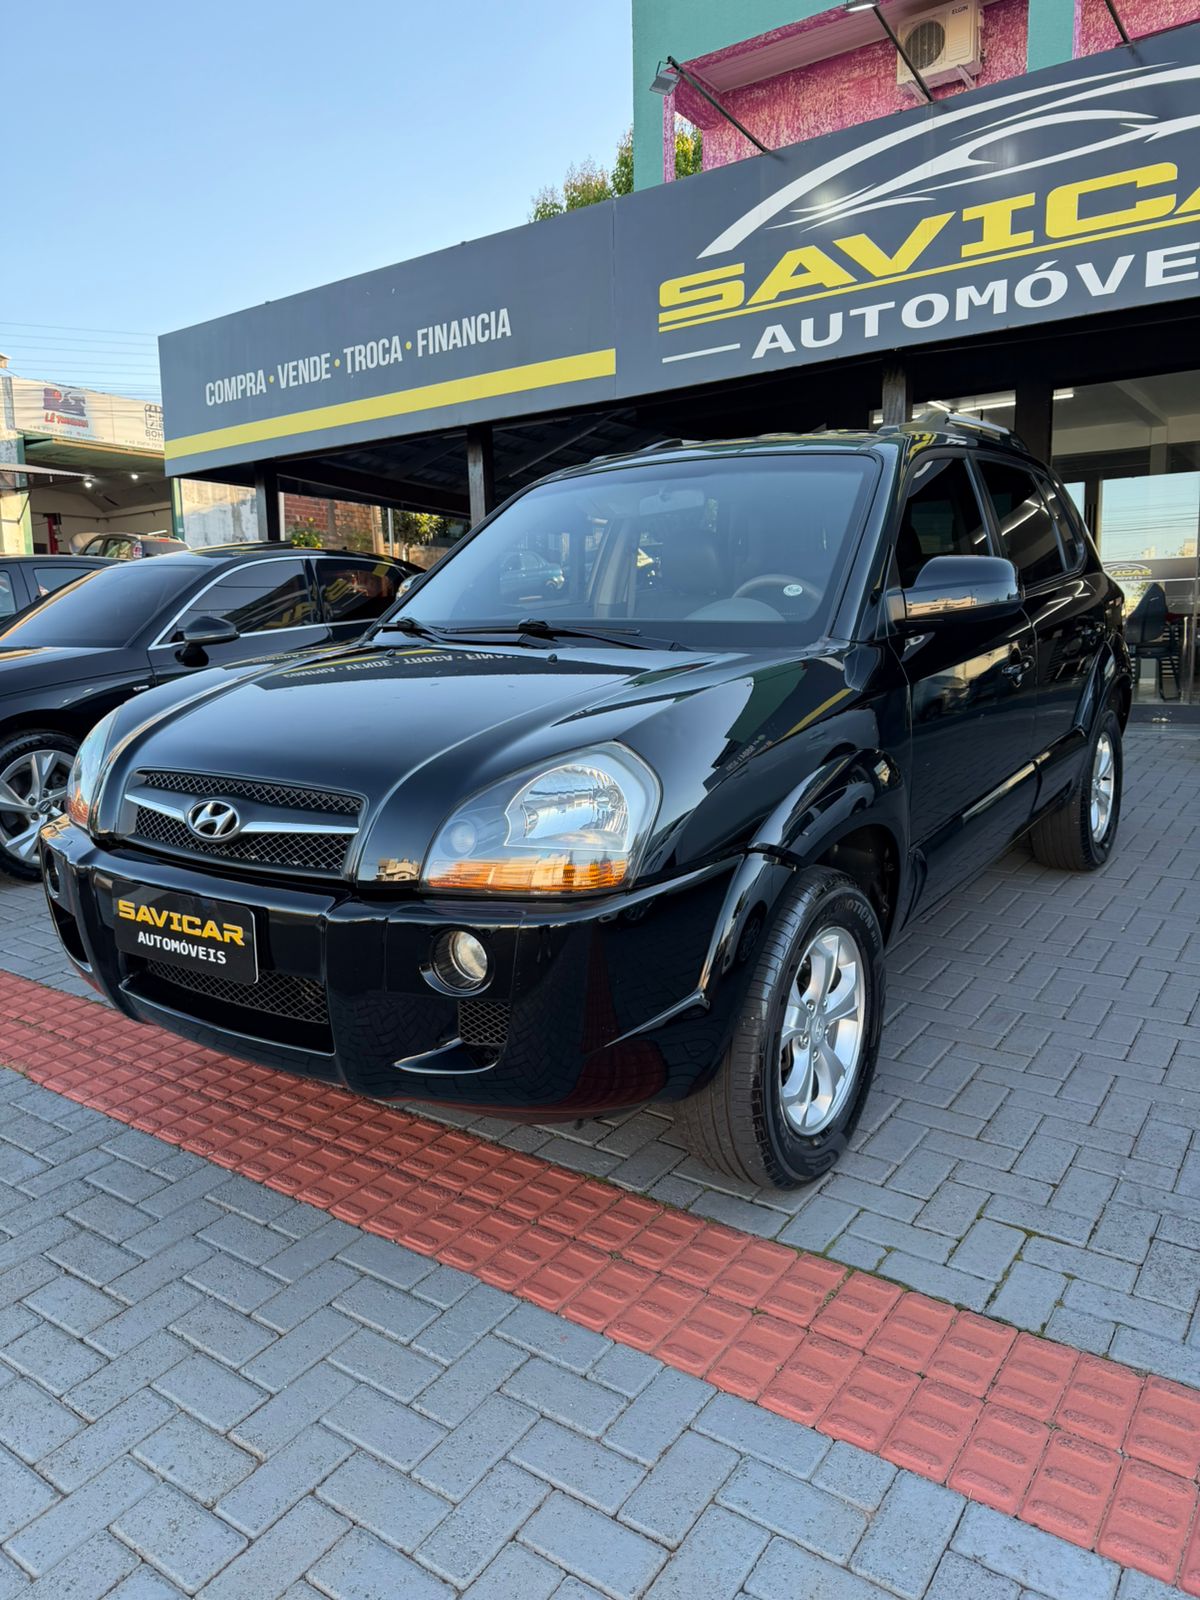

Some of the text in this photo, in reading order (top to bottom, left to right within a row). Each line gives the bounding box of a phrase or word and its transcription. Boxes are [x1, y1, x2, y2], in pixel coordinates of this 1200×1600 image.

[658, 162, 1200, 324] SAVIC
[205, 307, 512, 407] COMPRA VENDE TROCA FINANCIA
[117, 899, 246, 946] SAVICAR
[136, 930, 228, 966] AUTOMÓVEIS
